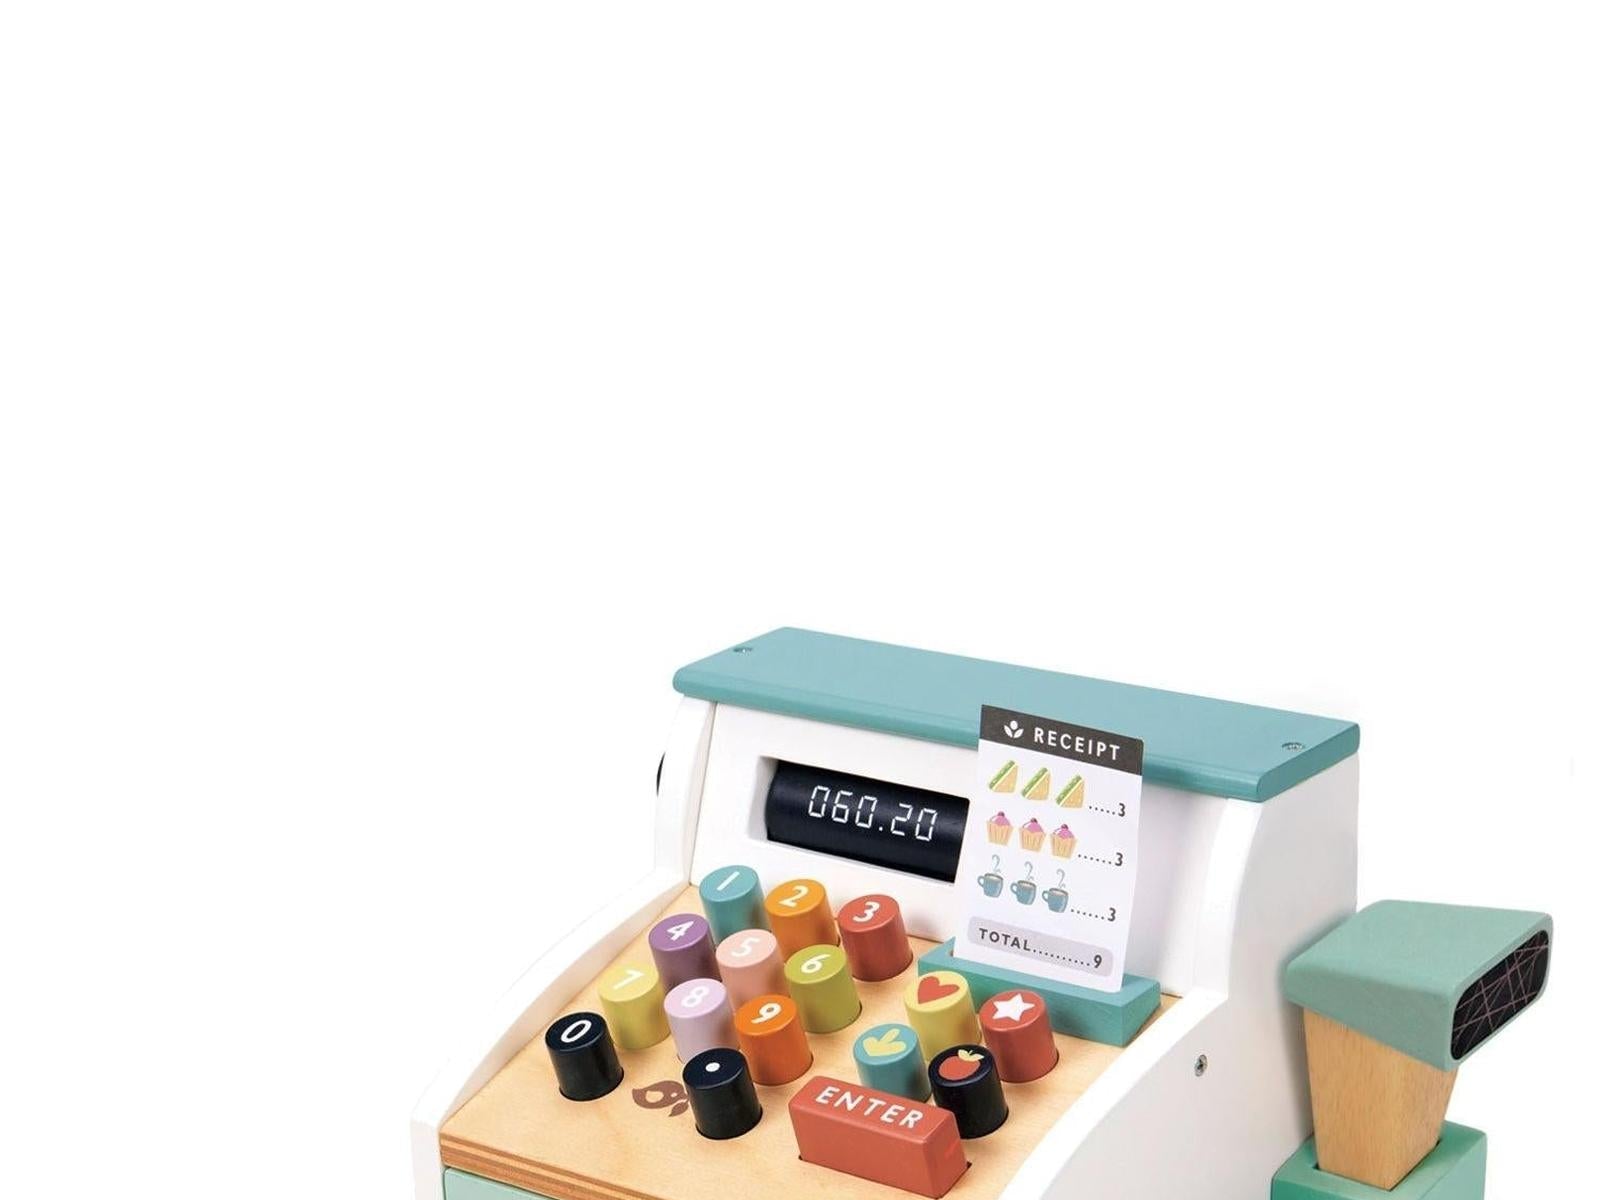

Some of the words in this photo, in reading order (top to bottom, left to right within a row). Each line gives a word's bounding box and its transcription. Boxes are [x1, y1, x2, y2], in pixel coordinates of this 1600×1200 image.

[1034, 727, 1121, 760] RECEIPT
[808, 785, 937, 842] 060.20
[716, 871, 740, 891] 1
[778, 885, 809, 907] 2
[852, 901, 881, 923] 3
[666, 920, 694, 941] 4
[730, 936, 761, 957] 5
[800, 953, 831, 974] 6
[612, 968, 645, 990] 7
[681, 985, 710, 1008] 8
[750, 1002, 782, 1024] 9
[560, 1019, 593, 1043] 0
[815, 1085, 924, 1129] ENTER
